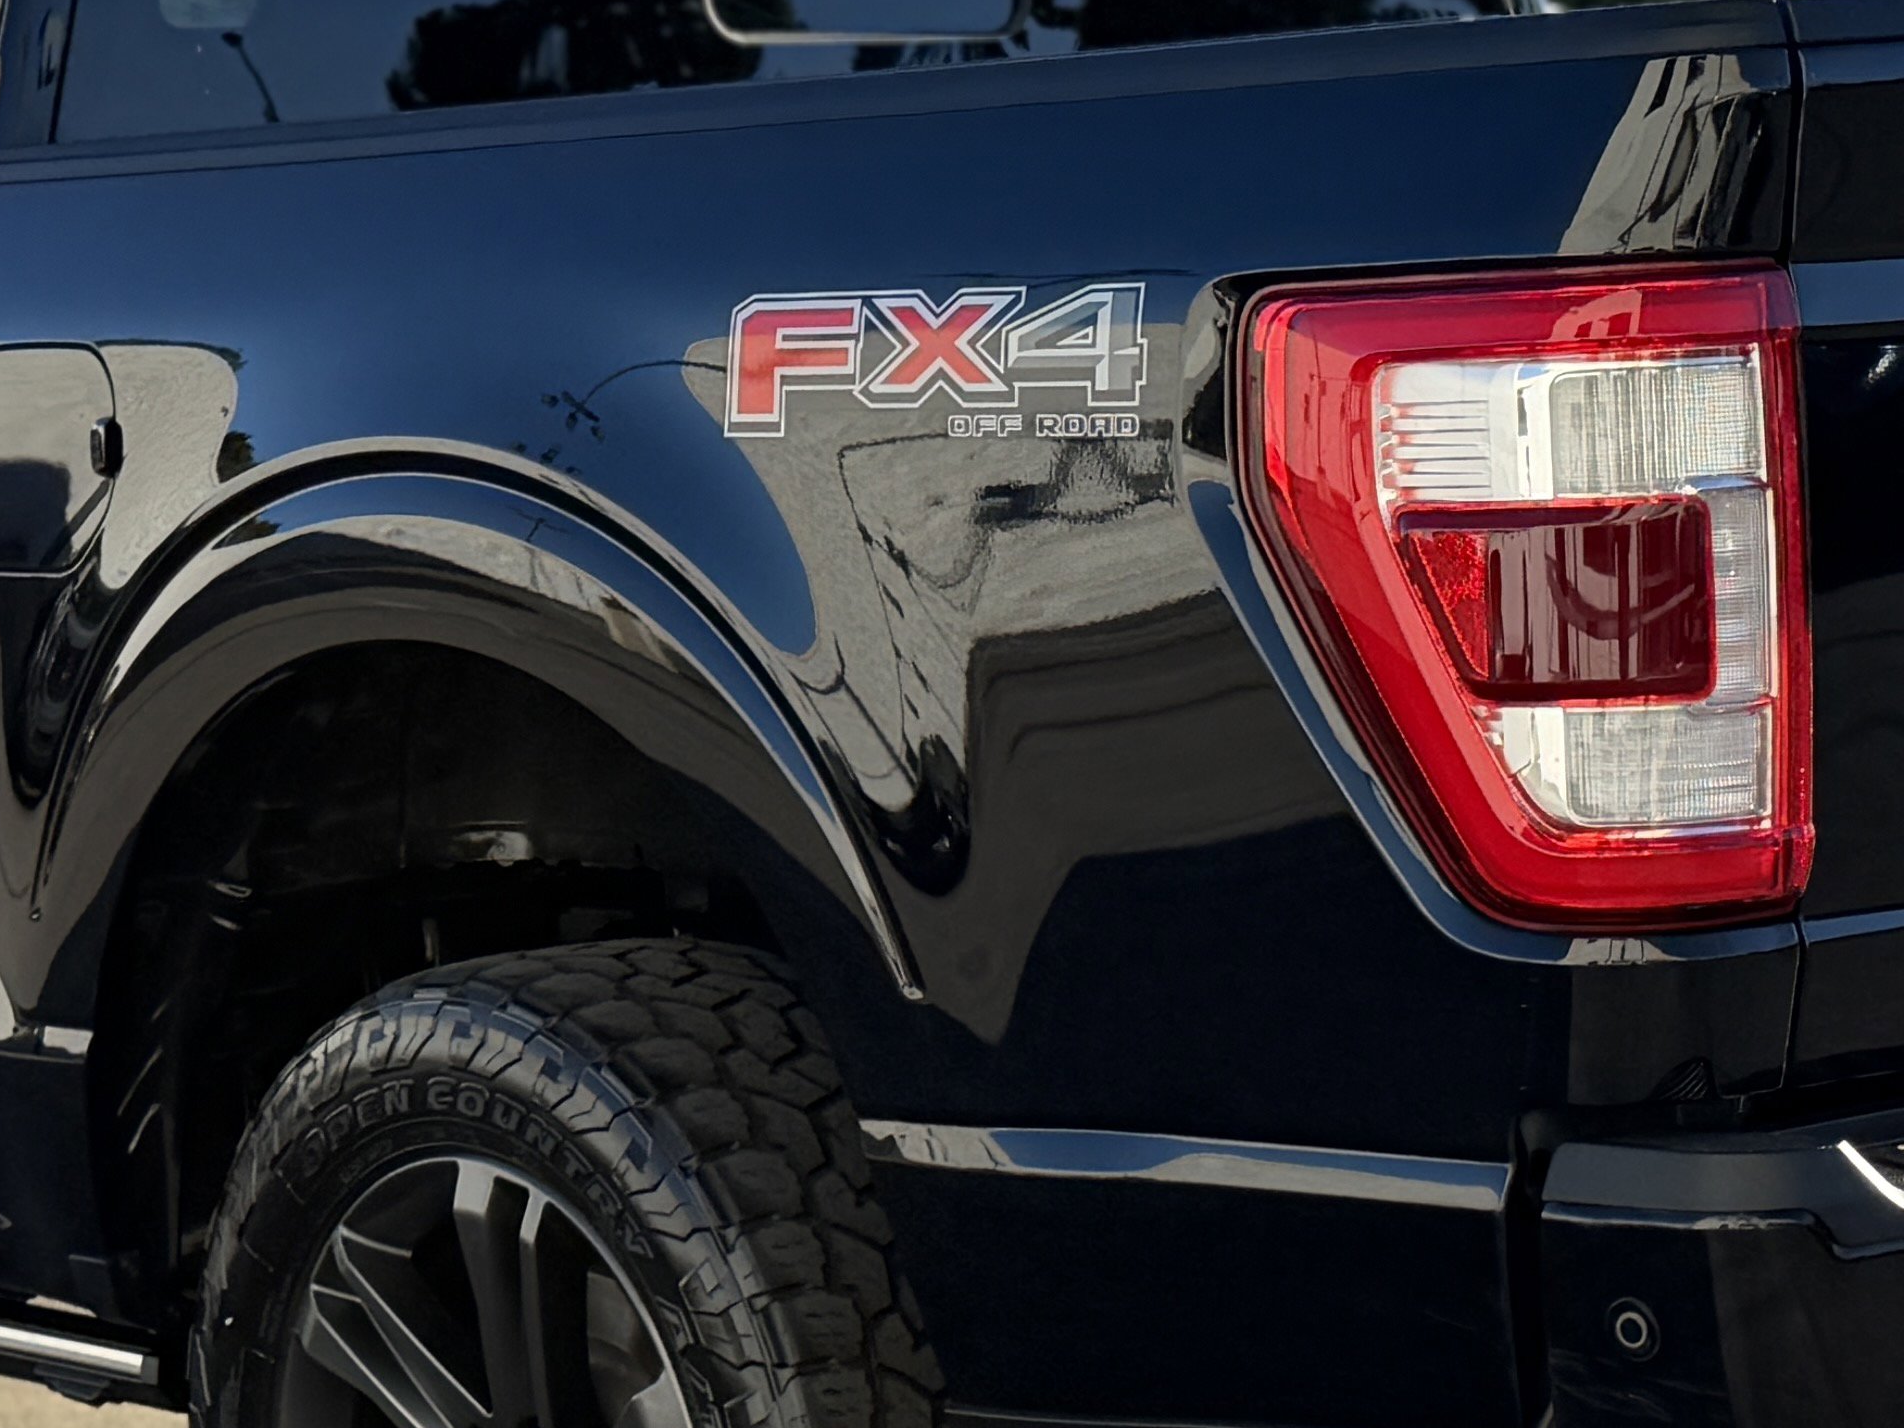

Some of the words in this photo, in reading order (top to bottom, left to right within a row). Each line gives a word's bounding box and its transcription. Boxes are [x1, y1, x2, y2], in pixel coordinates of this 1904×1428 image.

[724, 282, 1148, 438] FX4
[947, 413, 1022, 437] OFF
[1035, 413, 1140, 437] ROAD
[299, 1079, 415, 1174] OPEN
[426, 1076, 654, 1259] COUNTRY
